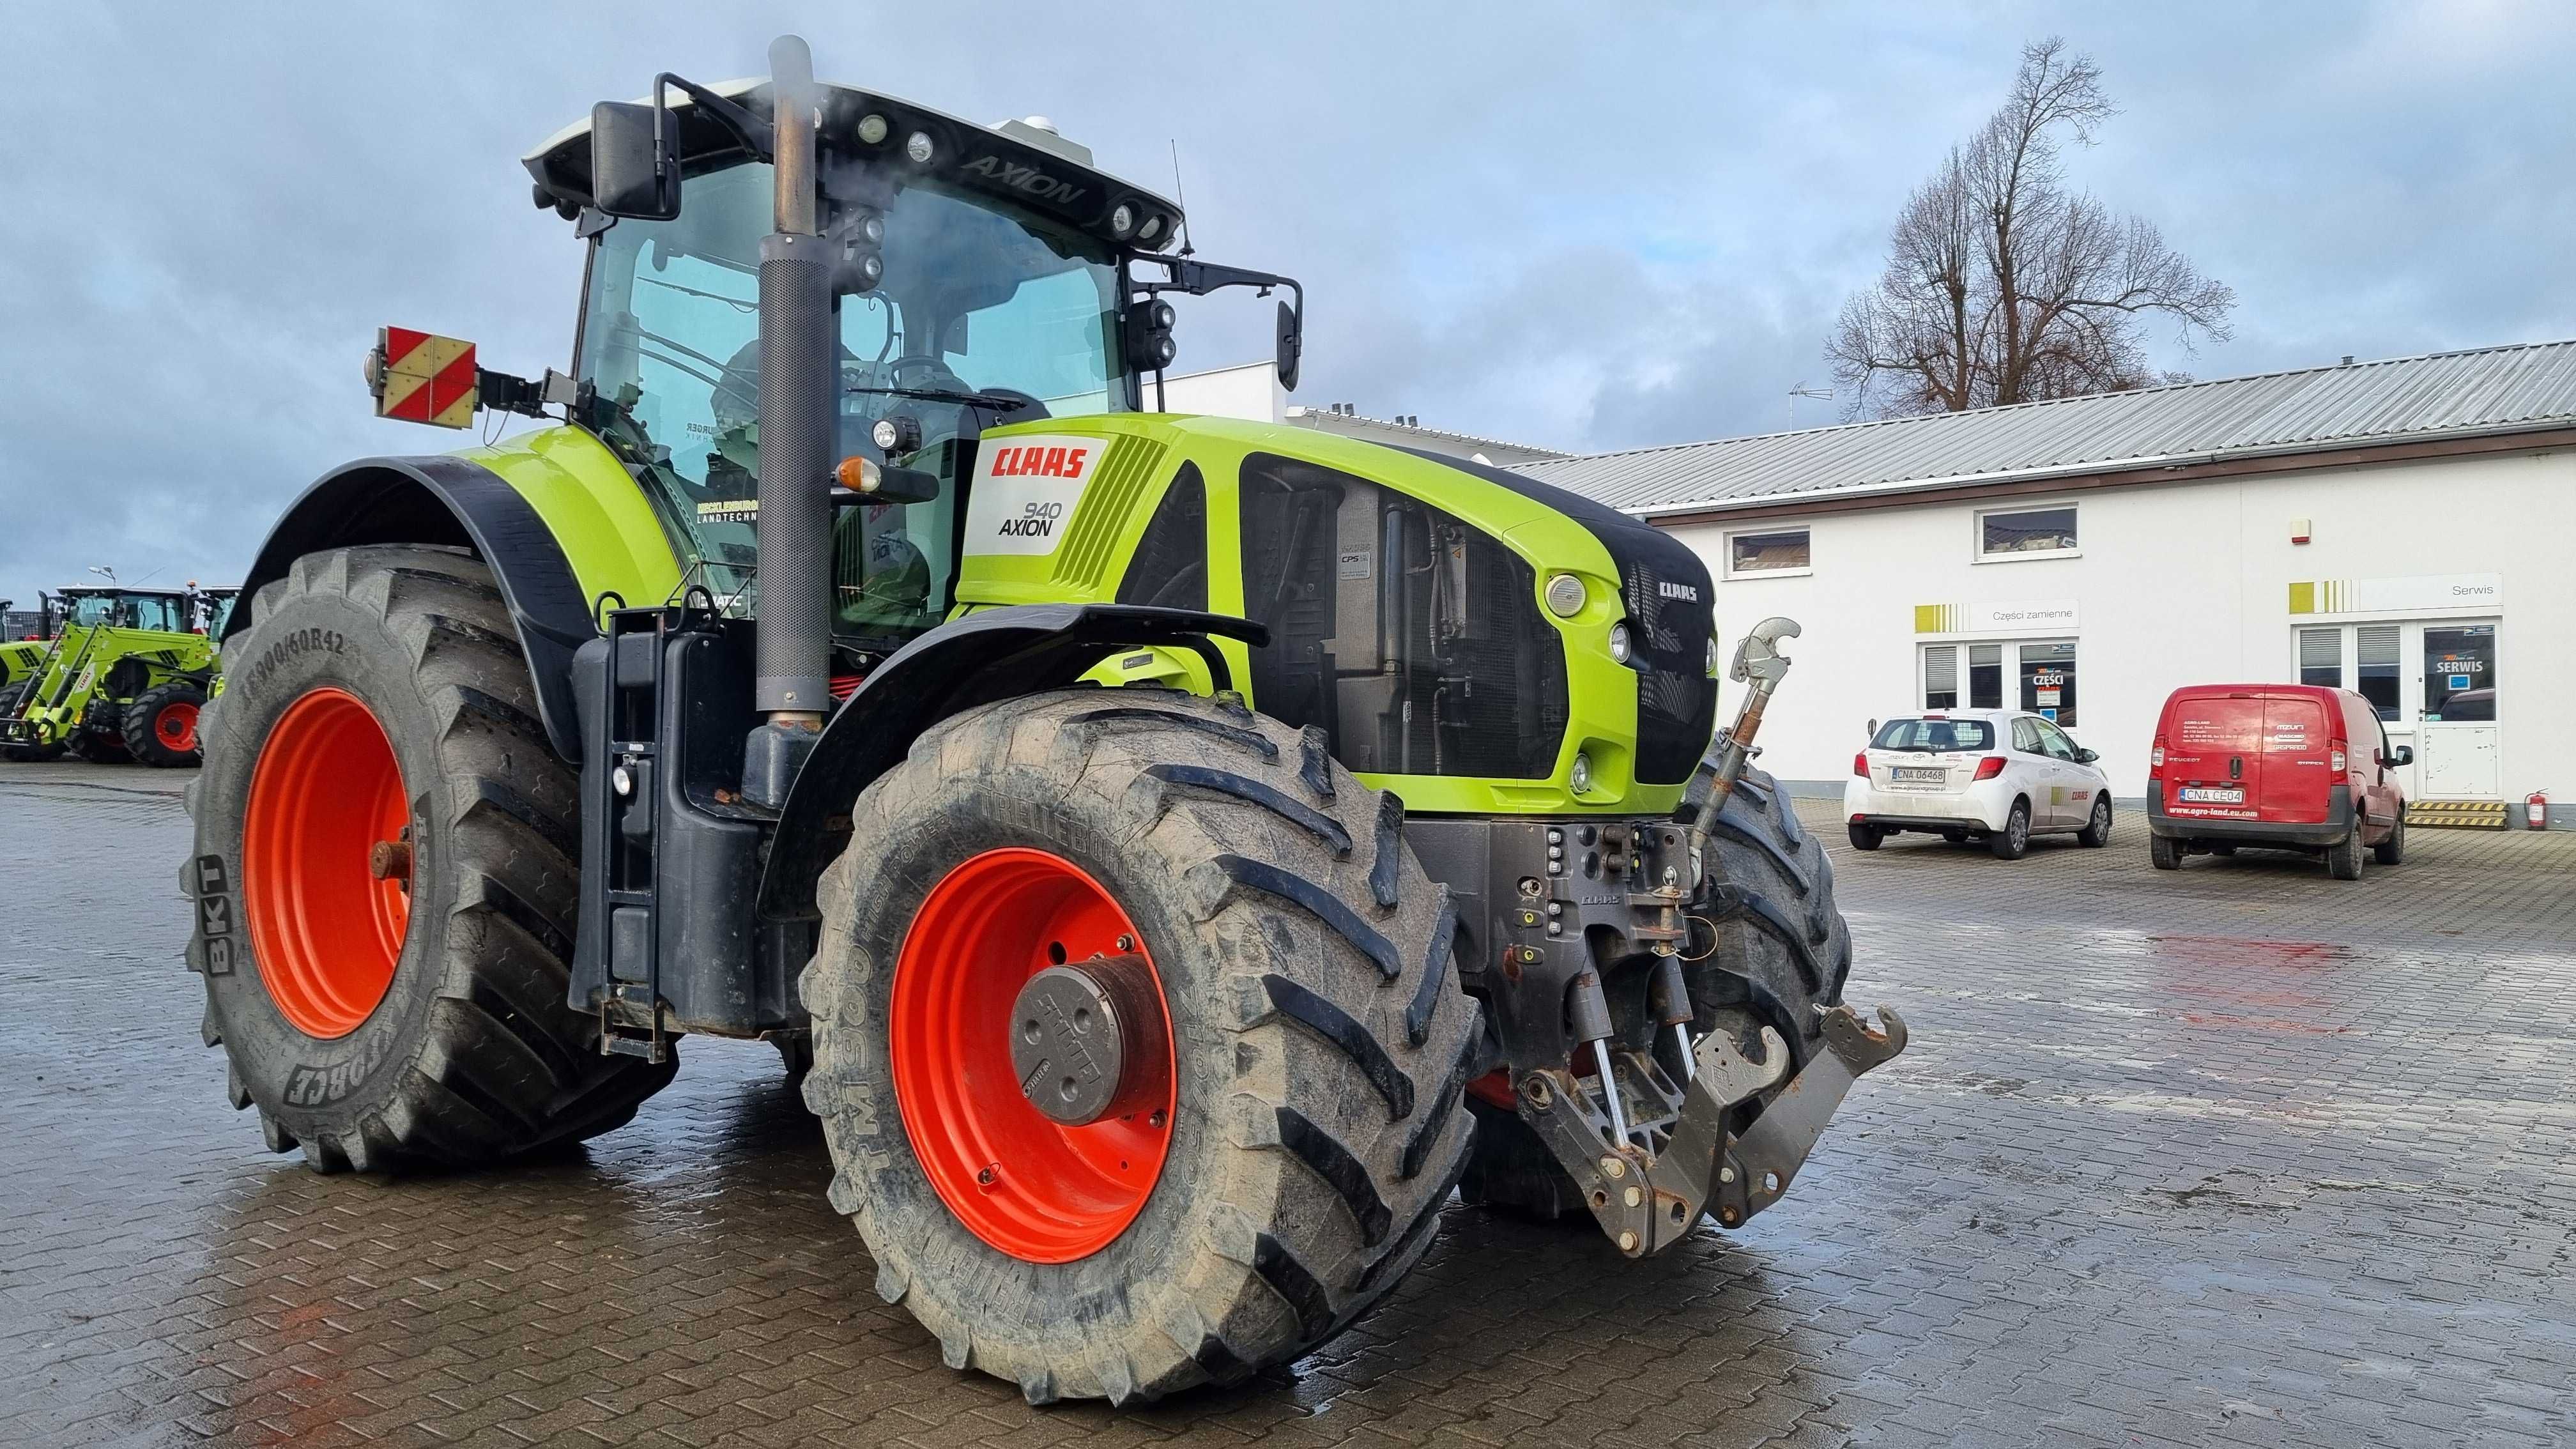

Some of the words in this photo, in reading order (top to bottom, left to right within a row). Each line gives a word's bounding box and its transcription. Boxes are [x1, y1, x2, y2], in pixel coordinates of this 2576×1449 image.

[961, 156, 1086, 204] AXION
[991, 447, 1088, 479] CLAAS
[697, 500, 758, 514] MECKLENBURG
[1023, 502, 1062, 519] 940
[999, 519, 1053, 537] AXION
[1659, 581, 1697, 601] CLAAS
[2453, 585, 2494, 595] Serwis
[1993, 611, 2024, 622] Części
[2027, 610, 2073, 619] zamienne
[2437, 661, 2483, 673] SERWIS
[2034, 673, 2064, 687] CZĘŚCI
[1897, 770, 1913, 779] CNA
[1916, 770, 1943, 779] 06468
[2187, 790, 2209, 800] CNA
[2213, 791, 2241, 801] CE04
[2169, 807, 2258, 817] www.agro-land.eu.com
[976, 782, 1142, 887] TRELLEBORG
[198, 857, 231, 975] BKT
